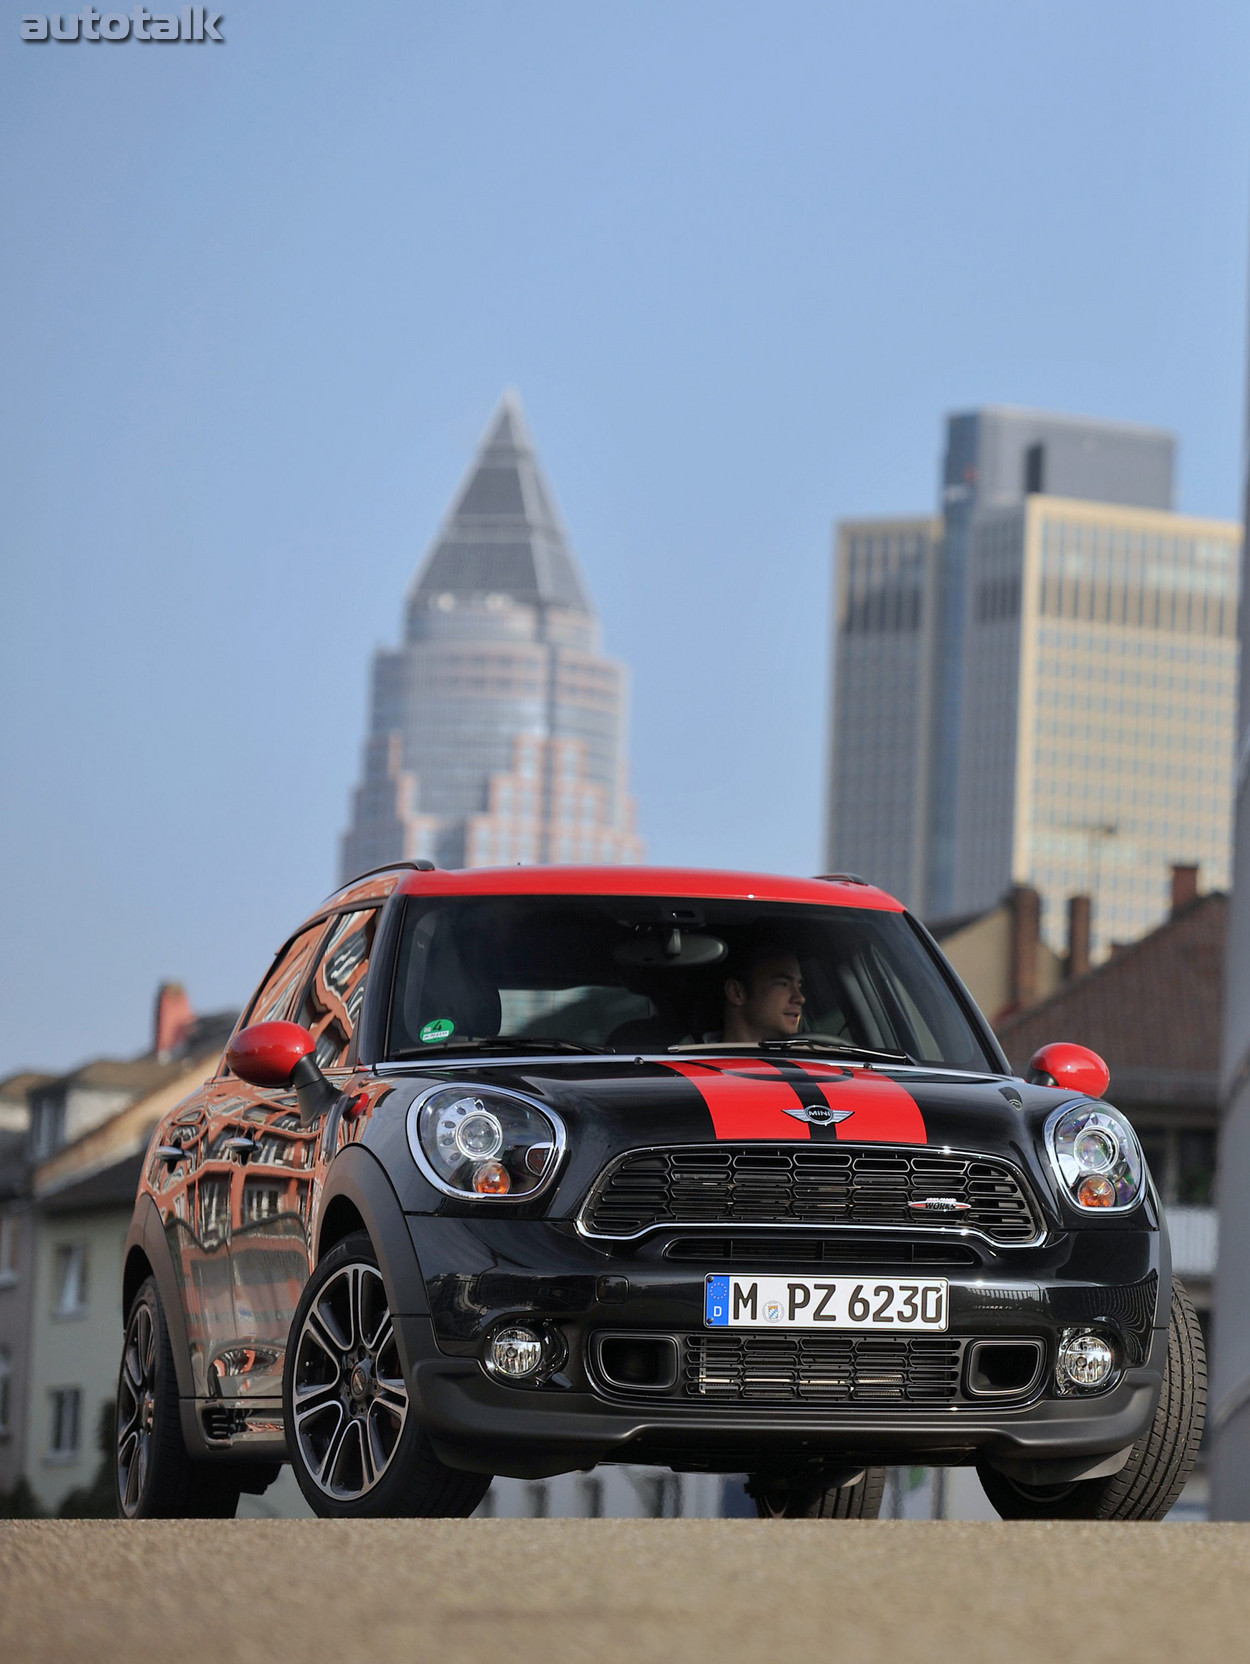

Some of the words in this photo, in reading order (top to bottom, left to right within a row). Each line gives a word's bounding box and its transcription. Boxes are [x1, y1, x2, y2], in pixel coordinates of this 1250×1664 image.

[432, 1020, 443, 1031] 4
[925, 1202, 956, 1210] WORKS
[733, 1282, 758, 1320] M
[787, 1283, 836, 1321] PZ
[848, 1284, 943, 1323] 6230
[713, 1305, 722, 1317] D
